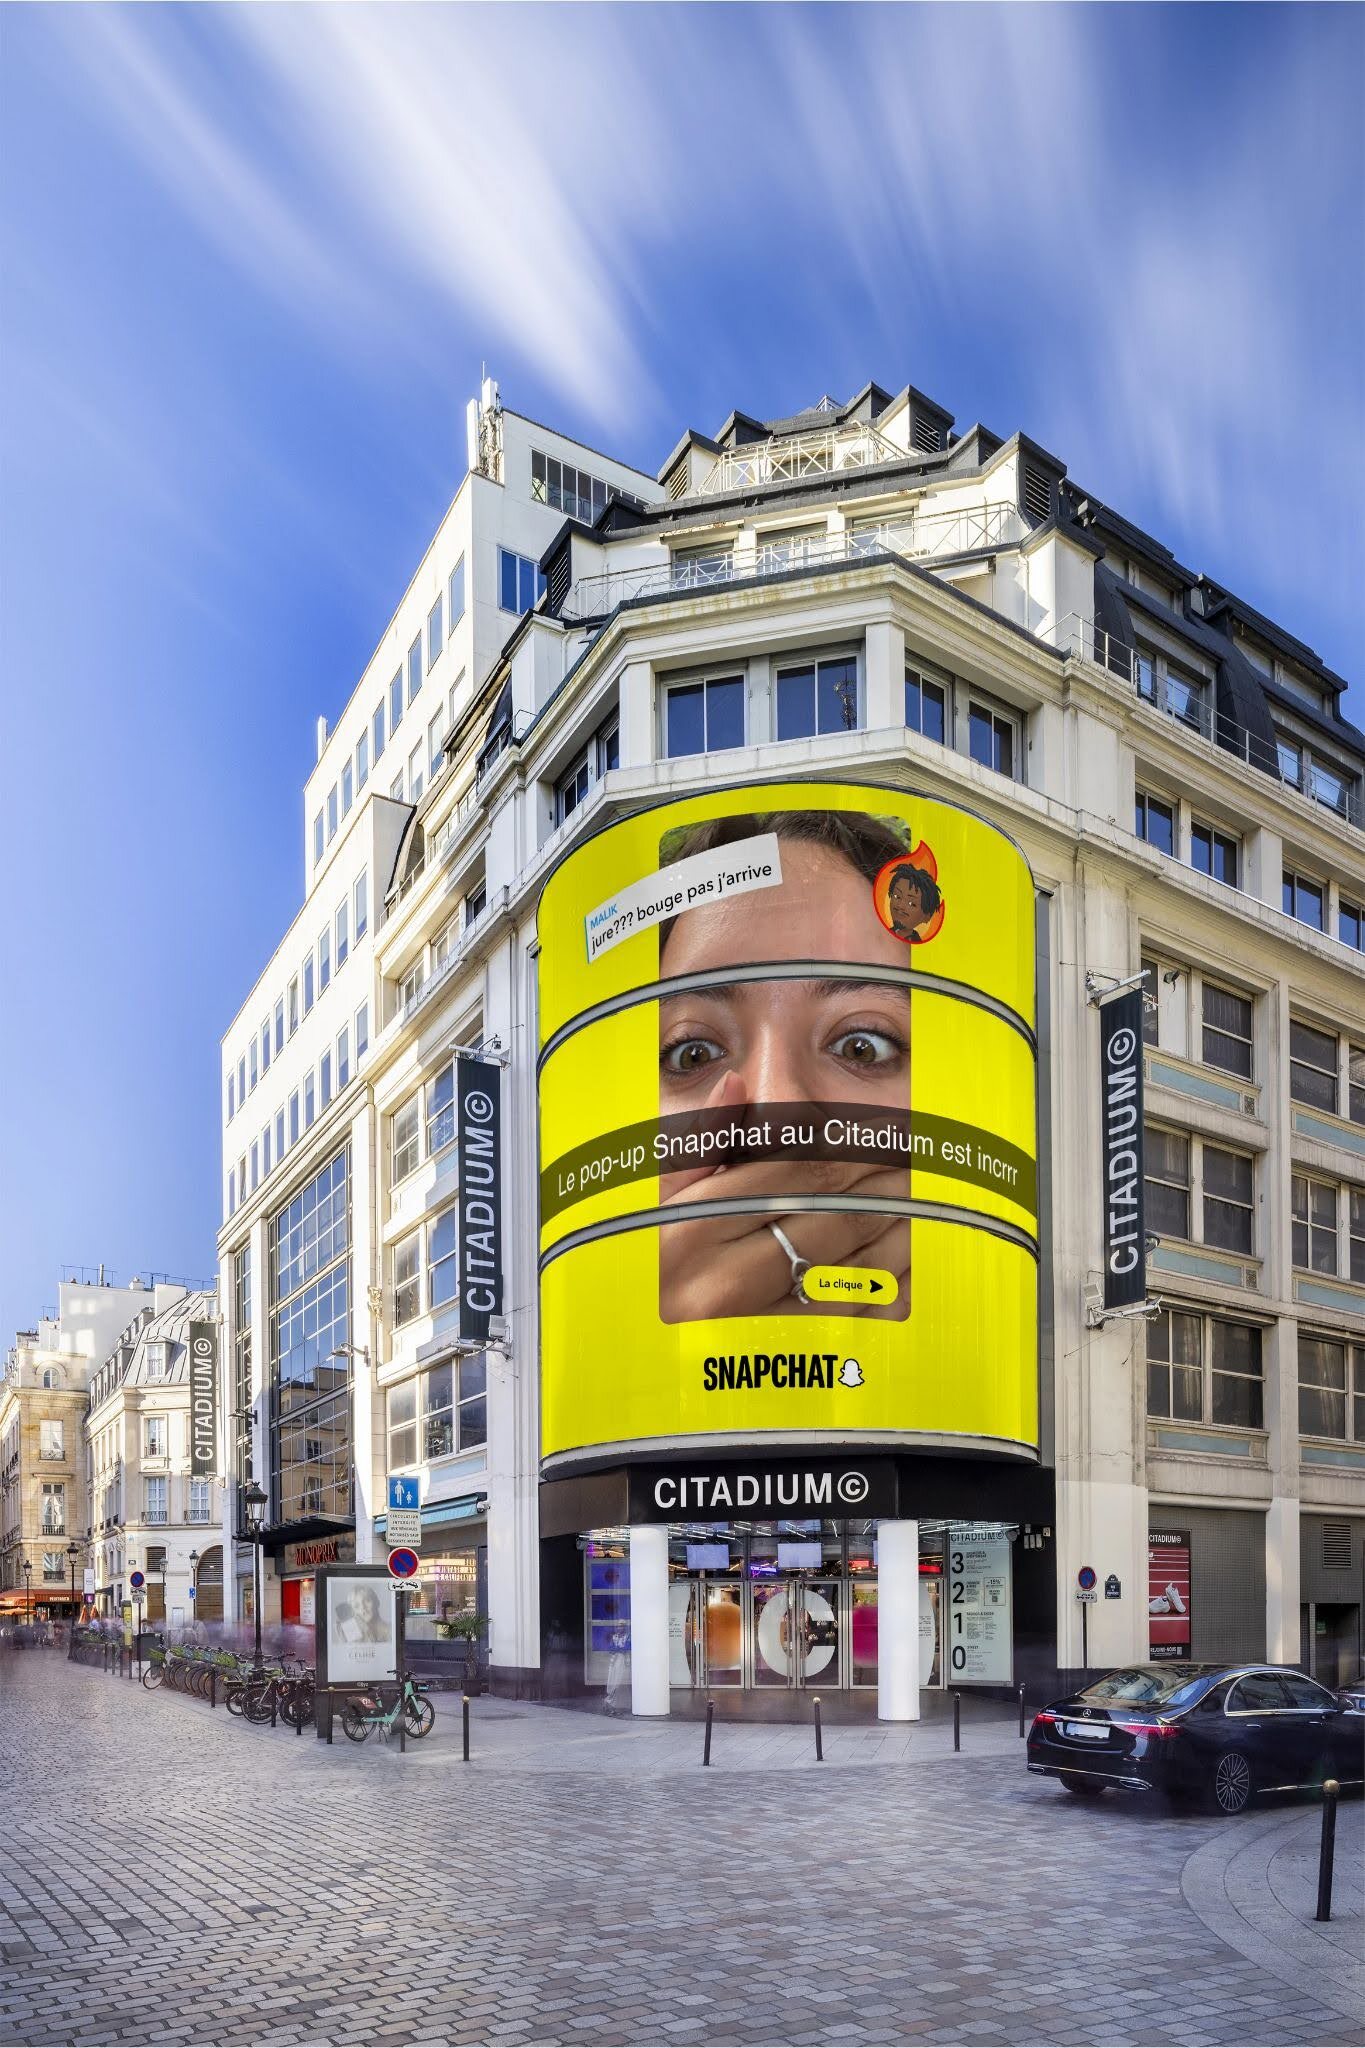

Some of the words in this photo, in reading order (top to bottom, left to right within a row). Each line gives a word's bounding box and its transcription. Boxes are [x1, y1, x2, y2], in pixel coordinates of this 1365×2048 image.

[590, 903, 618, 931] MALIK
[591, 912, 633, 955] jure???
[637, 891, 683, 921] bouge
[687, 879, 714, 902] pas
[717, 864, 772, 892] j'arrive
[558, 1172, 575, 1197] Le
[580, 1145, 645, 1191] pop-up
[653, 1121, 771, 1160] Snapchat
[781, 1124, 813, 1145] au
[824, 1119, 934, 1157] Citadium
[941, 1141, 972, 1167] est
[978, 1147, 1018, 1186] incrrr
[819, 1279, 831, 1288] La
[833, 1279, 863, 1290] clique
[703, 1354, 838, 1391] SNAPCHAT
[296, 1541, 337, 1567] MONOPRIX
[951, 1551, 965, 1574] 3
[952, 1581, 965, 1604] 2
[953, 1612, 963, 1634] 1
[952, 1645, 967, 1670] 0
